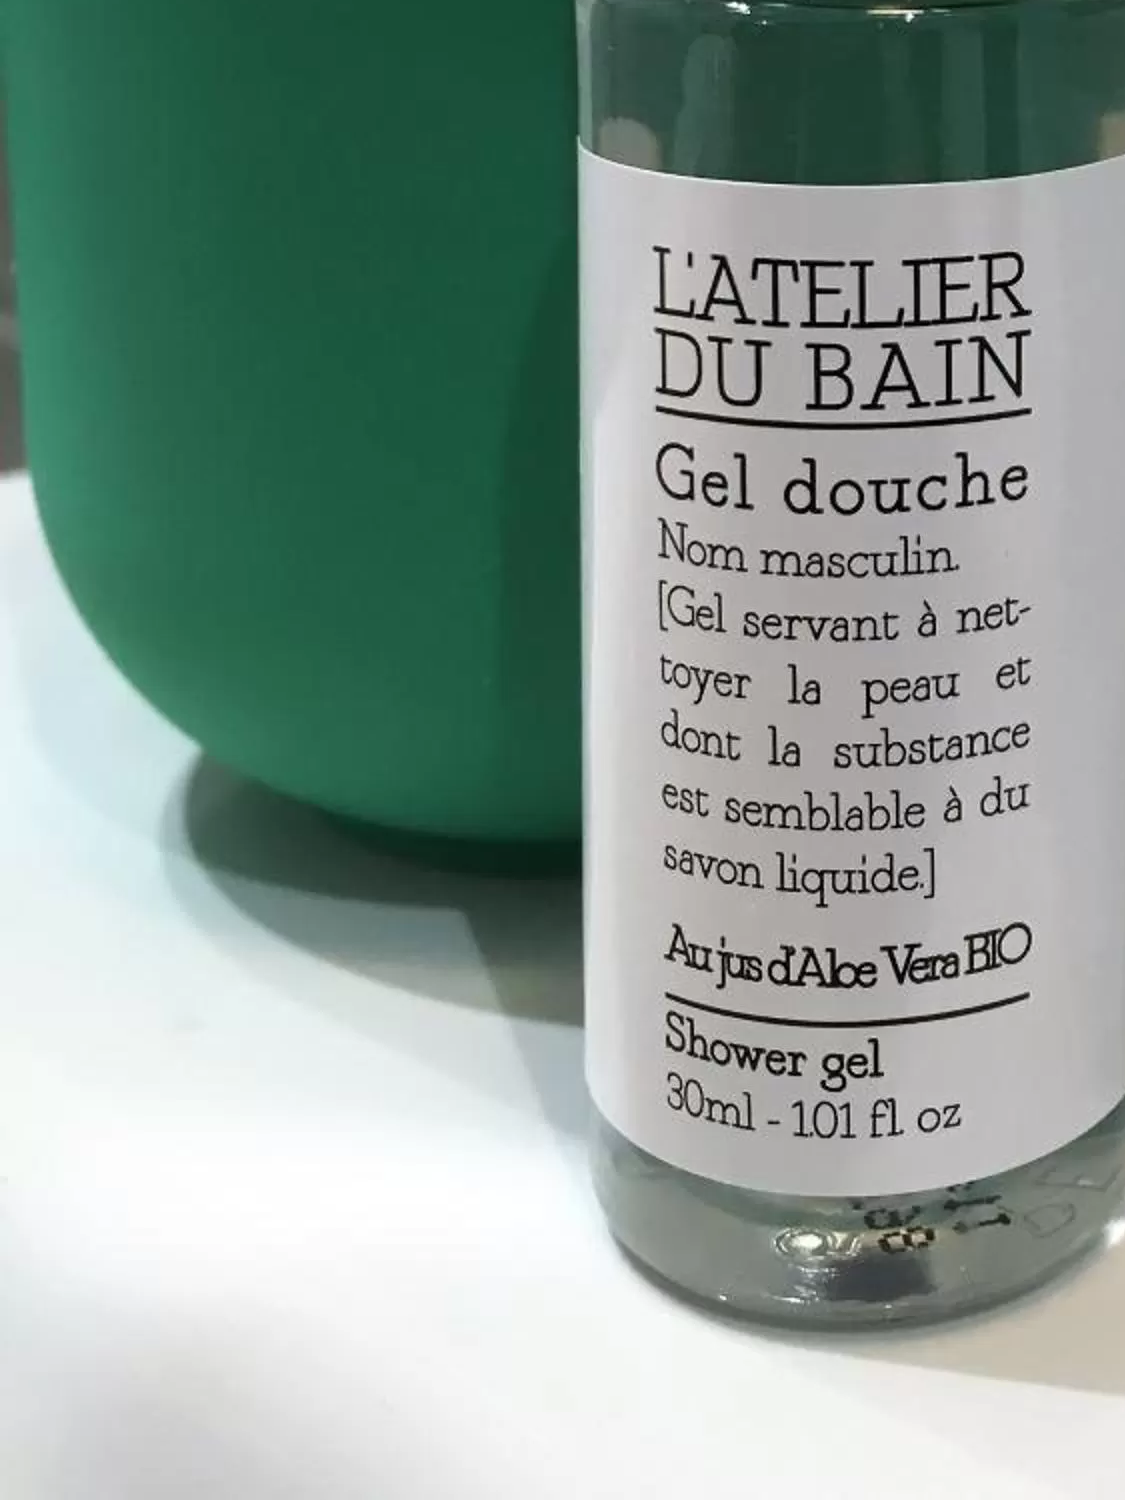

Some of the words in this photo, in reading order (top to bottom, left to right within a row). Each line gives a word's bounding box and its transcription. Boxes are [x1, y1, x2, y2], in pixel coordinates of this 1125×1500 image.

[651, 244, 1033, 331] L'ATELIER
[652, 326, 774, 408] DU
[803, 327, 1033, 412] BAIN
[655, 441, 756, 512] Gel
[782, 451, 1029, 517] douche
[656, 516, 749, 574] Nom
[657, 578, 728, 634] [Gel
[742, 596, 901, 644] servant
[916, 598, 938, 639] à
[954, 596, 1033, 636] net-
[659, 653, 753, 707] toyer
[786, 662, 822, 707] la
[860, 672, 961, 721] peau
[995, 655, 1033, 691] et
[660, 707, 742, 762] dont
[767, 723, 801, 769] la
[833, 721, 1032, 770] substance
[661, 783, 711, 819] est
[723, 788, 927, 833] semblable
[942, 784, 963, 824] à
[979, 774, 1032, 818] du
[663, 844, 766, 890] savon
[774, 846, 937, 909] liquide.]
[663, 922, 715, 974] Au
[715, 935, 764, 991] jus
[879, 941, 961, 987] Vera
[962, 921, 1034, 977] BIO
[664, 1009, 809, 1078] Shower
[818, 1037, 886, 1094] gel
[666, 1070, 757, 1133] 30ml
[916, 1103, 963, 1134] oz
